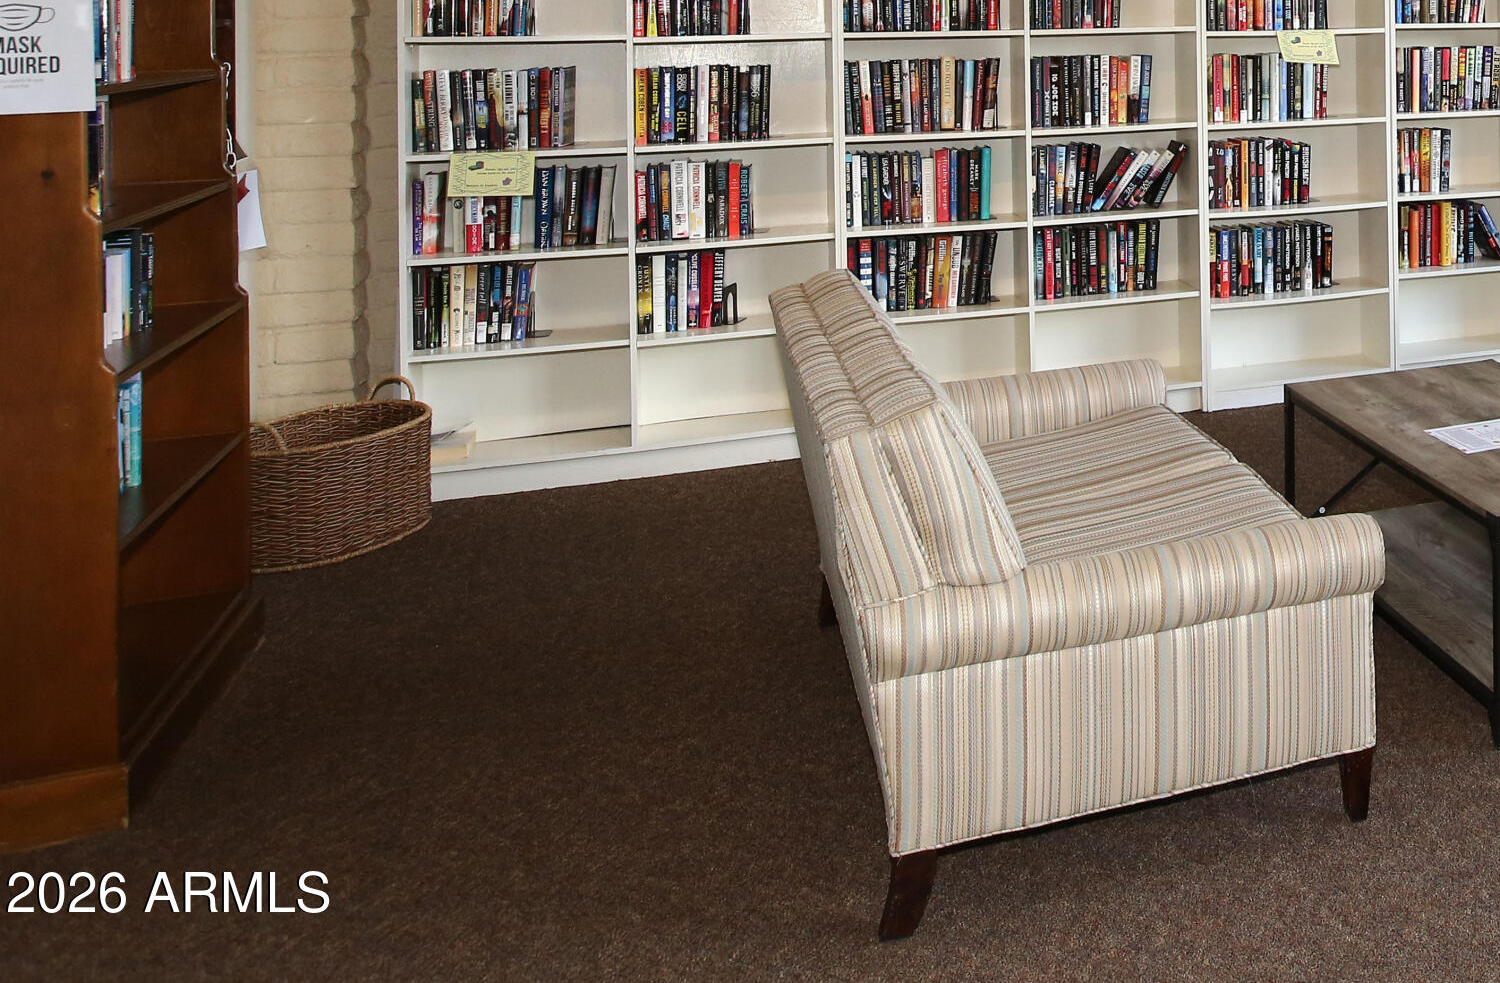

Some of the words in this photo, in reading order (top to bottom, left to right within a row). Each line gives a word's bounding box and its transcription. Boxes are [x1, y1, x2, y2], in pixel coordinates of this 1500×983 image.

[0, 55, 61, 76] QUIRED
[892, 64, 901, 82] JOSEPH
[894, 82, 902, 100] FINDER
[426, 100, 435, 127] STRING
[677, 111, 686, 132] CELL
[541, 170, 550, 186] DAN
[674, 162, 683, 184] PATRICIA
[692, 164, 700, 184] PATRICIA
[740, 170, 748, 196] ROBERT
[541, 188, 550, 215] BROWN
[675, 186, 686, 212] CORNWELL
[692, 186, 700, 210] CORNWELL
[714, 252, 723, 278] JEFFERY
[952, 248, 960, 269] UNSUB
[714, 280, 722, 303] DEAVER
